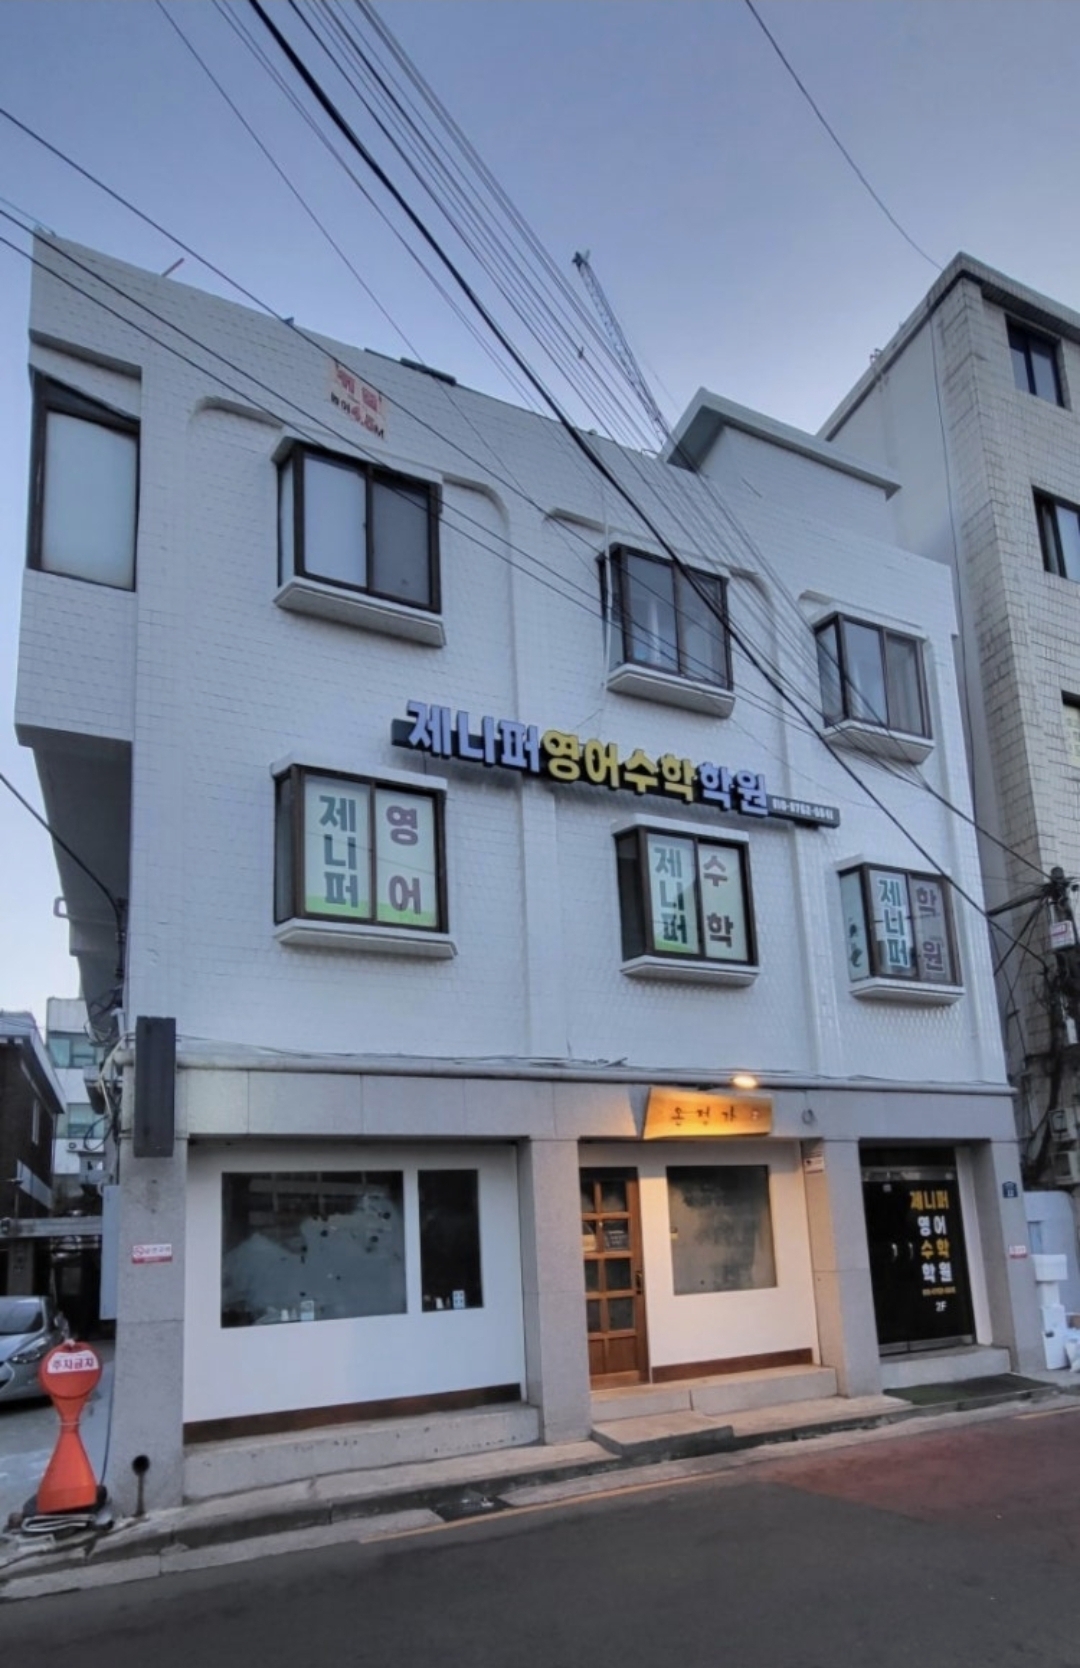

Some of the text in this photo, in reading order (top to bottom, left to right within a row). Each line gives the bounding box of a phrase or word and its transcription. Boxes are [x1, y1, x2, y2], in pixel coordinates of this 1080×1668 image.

[319, 795, 359, 909] 제니퍼
[386, 805, 422, 916] 영어
[653, 846, 688, 945] 제니퍼
[703, 855, 734, 949] 수학
[878, 879, 909, 967] 제니퍼
[916, 887, 944, 972] 학원
[909, 1190, 950, 1211] 제니퍼
[917, 1215, 947, 1237] 영어
[920, 1239, 950, 1260] 수학
[921, 1261, 953, 1283] 학원
